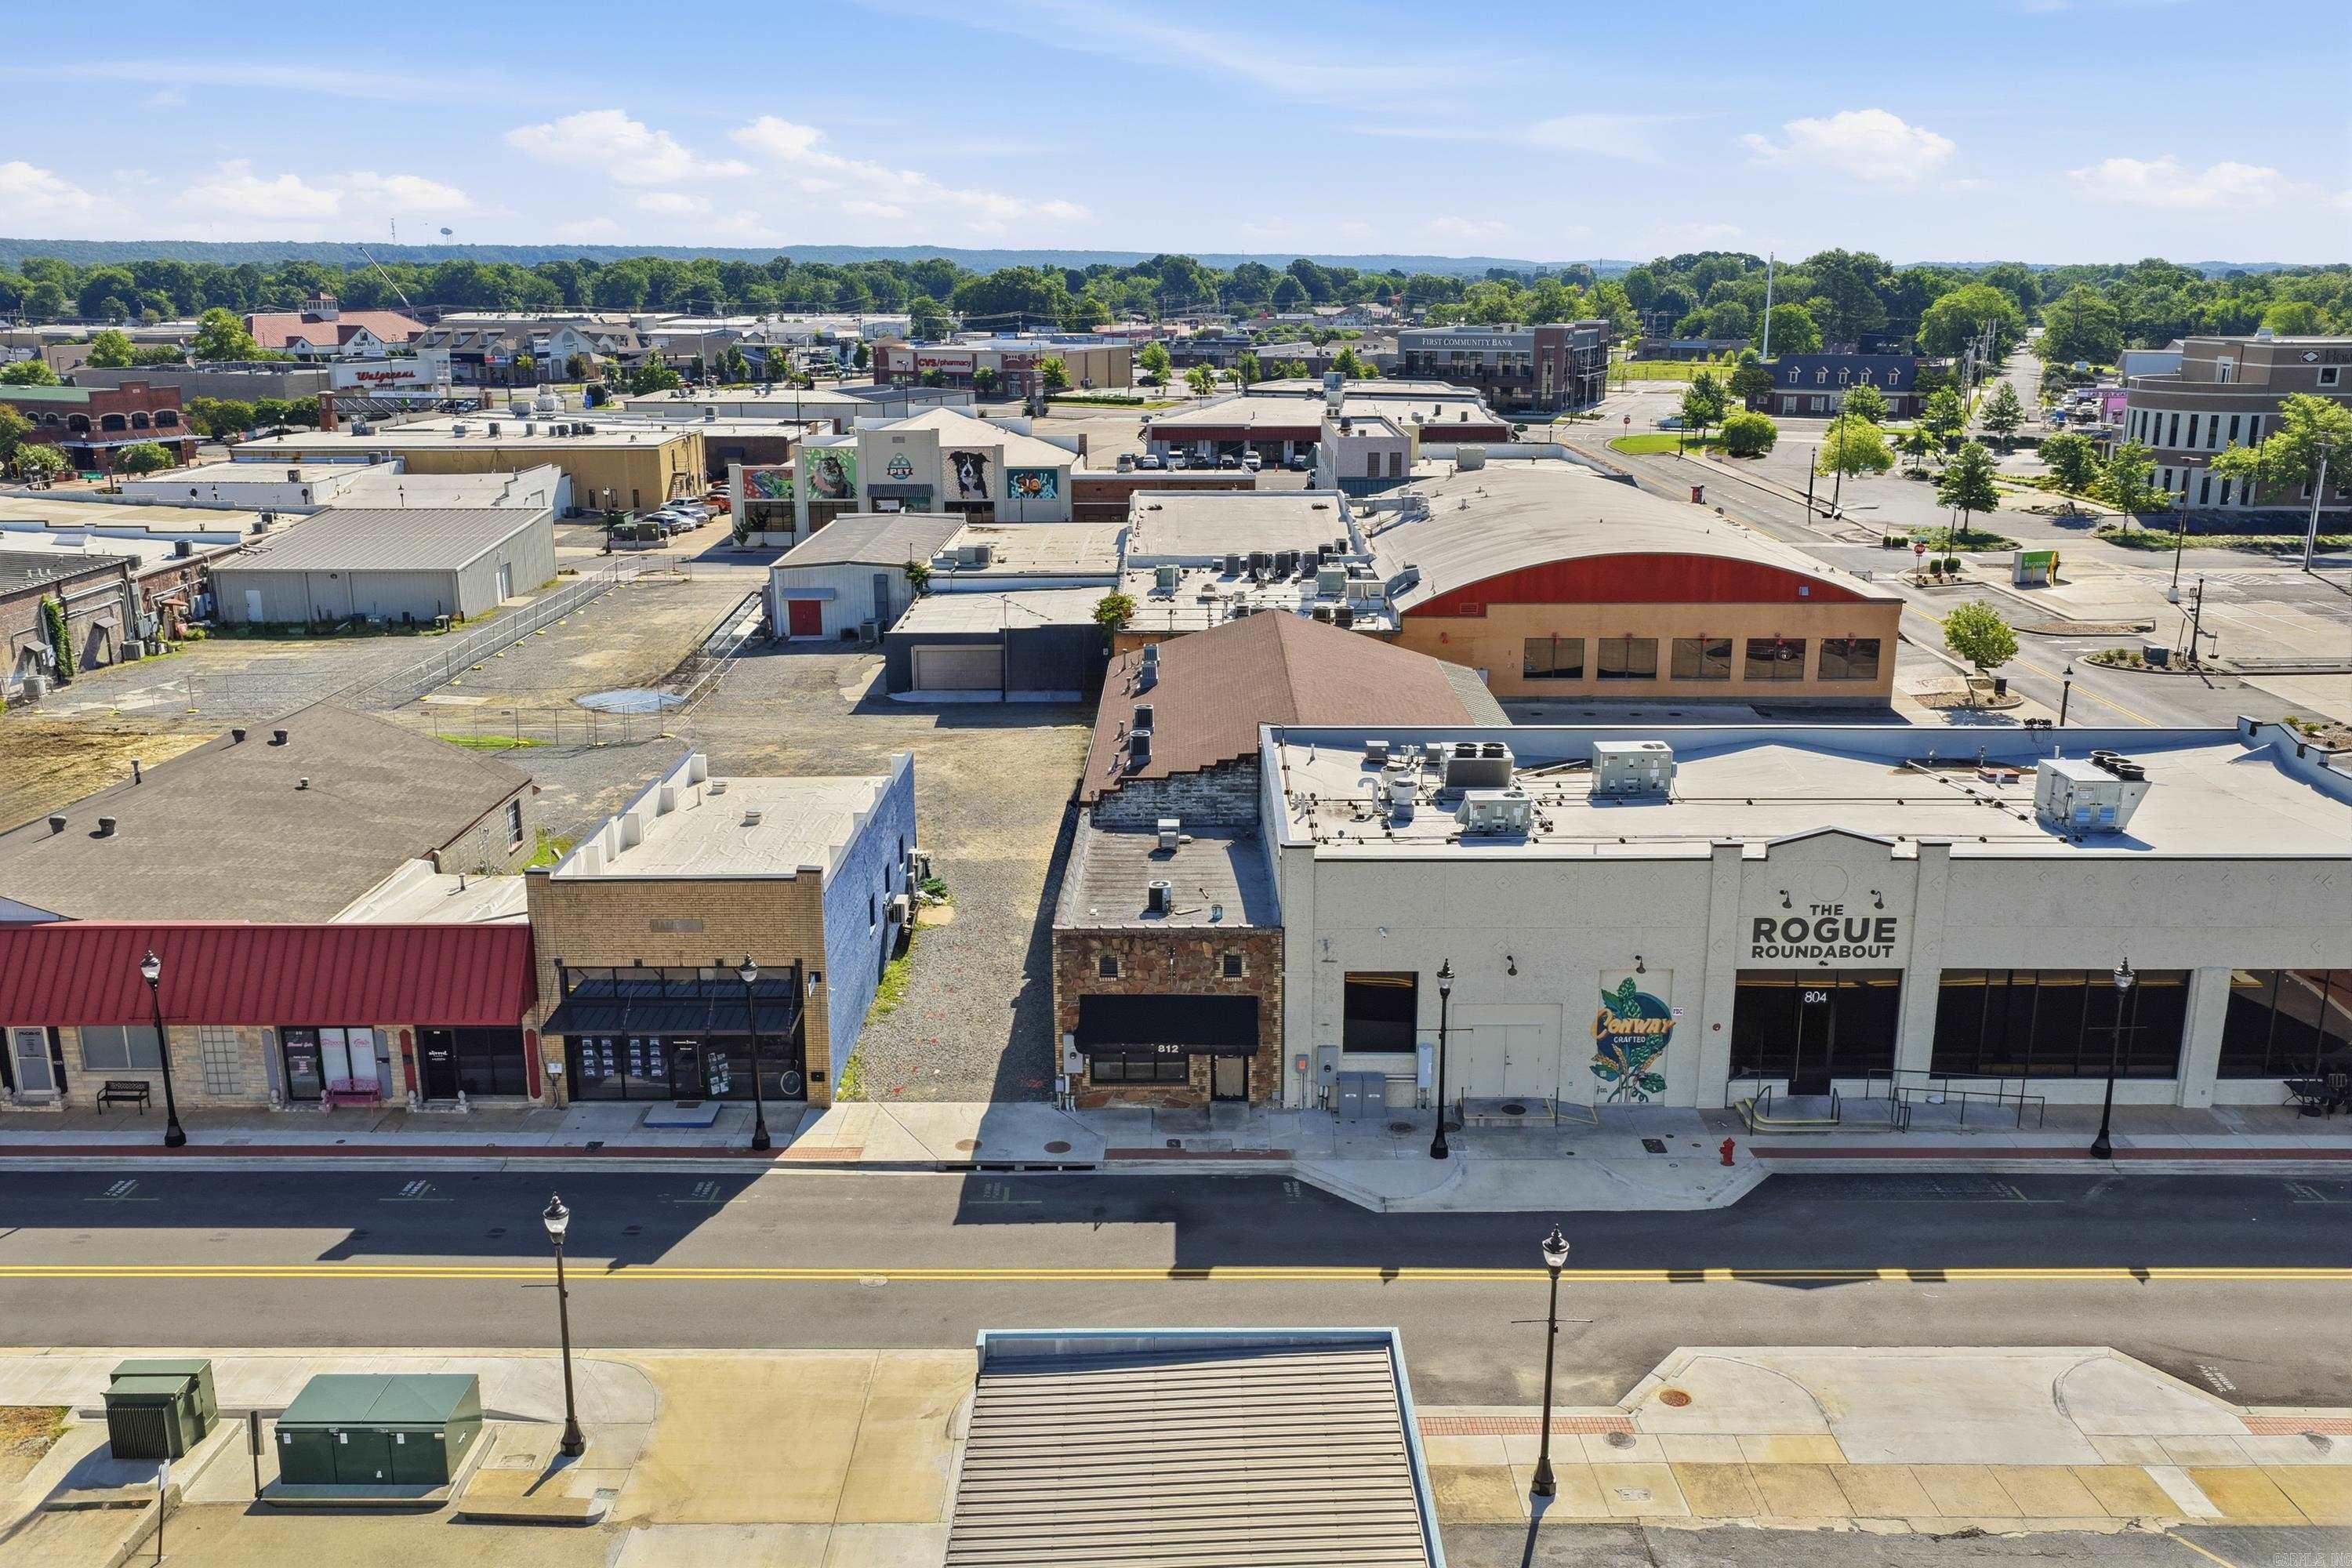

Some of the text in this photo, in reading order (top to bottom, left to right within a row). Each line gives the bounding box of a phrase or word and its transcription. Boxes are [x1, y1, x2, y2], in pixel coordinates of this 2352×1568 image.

[1443, 338, 1490, 347] COMMUNITY
[918, 358, 972, 368] CVS/pharmacy
[355, 371, 416, 383] Walgreens
[1809, 904, 1844, 916] THE
[1752, 916, 1897, 944] ROGUE
[1751, 945, 1894, 959] ROUNDABOUT
[1804, 991, 1828, 1003] 804
[1613, 1035, 1646, 1044] CRAFTED
[1157, 1044, 1179, 1053] 812
[2196, 1365, 2227, 1392] PARKING
